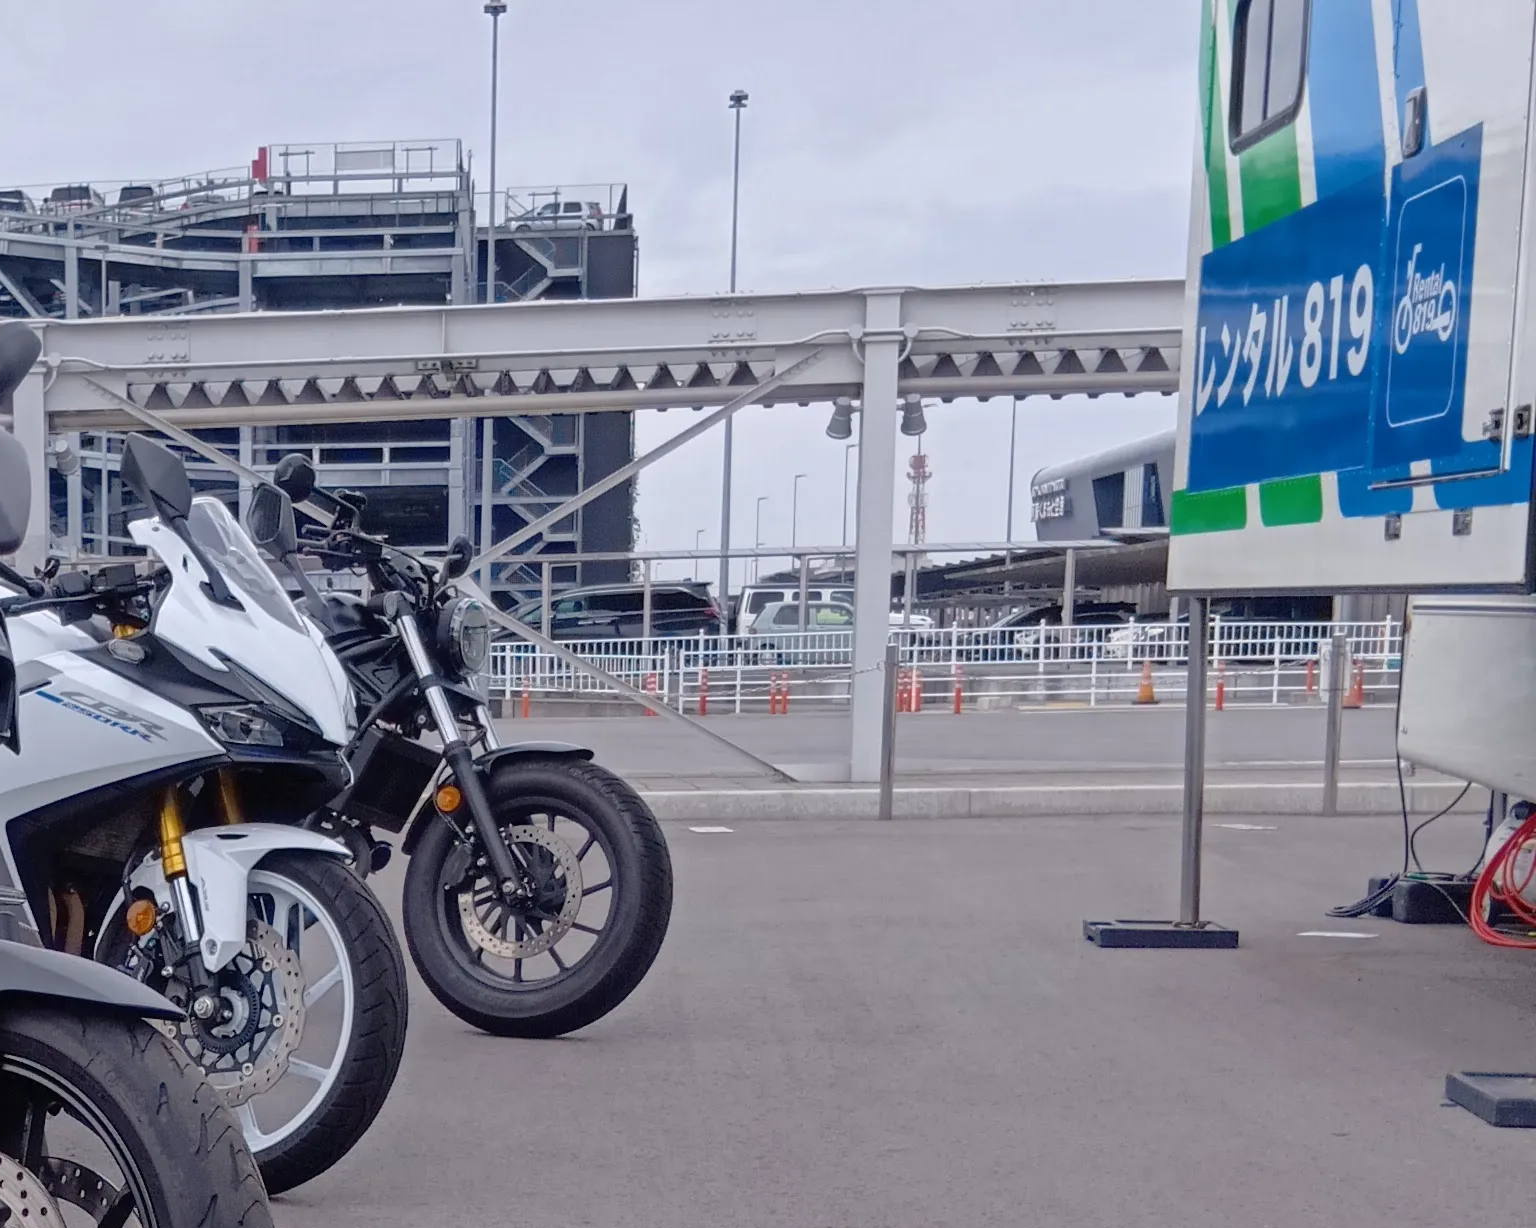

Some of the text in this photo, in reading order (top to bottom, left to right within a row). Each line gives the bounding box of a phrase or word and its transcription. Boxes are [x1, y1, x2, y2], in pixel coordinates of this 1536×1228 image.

[1412, 262, 1445, 304] Rental
[1412, 298, 1436, 335] 819
[60, 691, 168, 741] CBR
